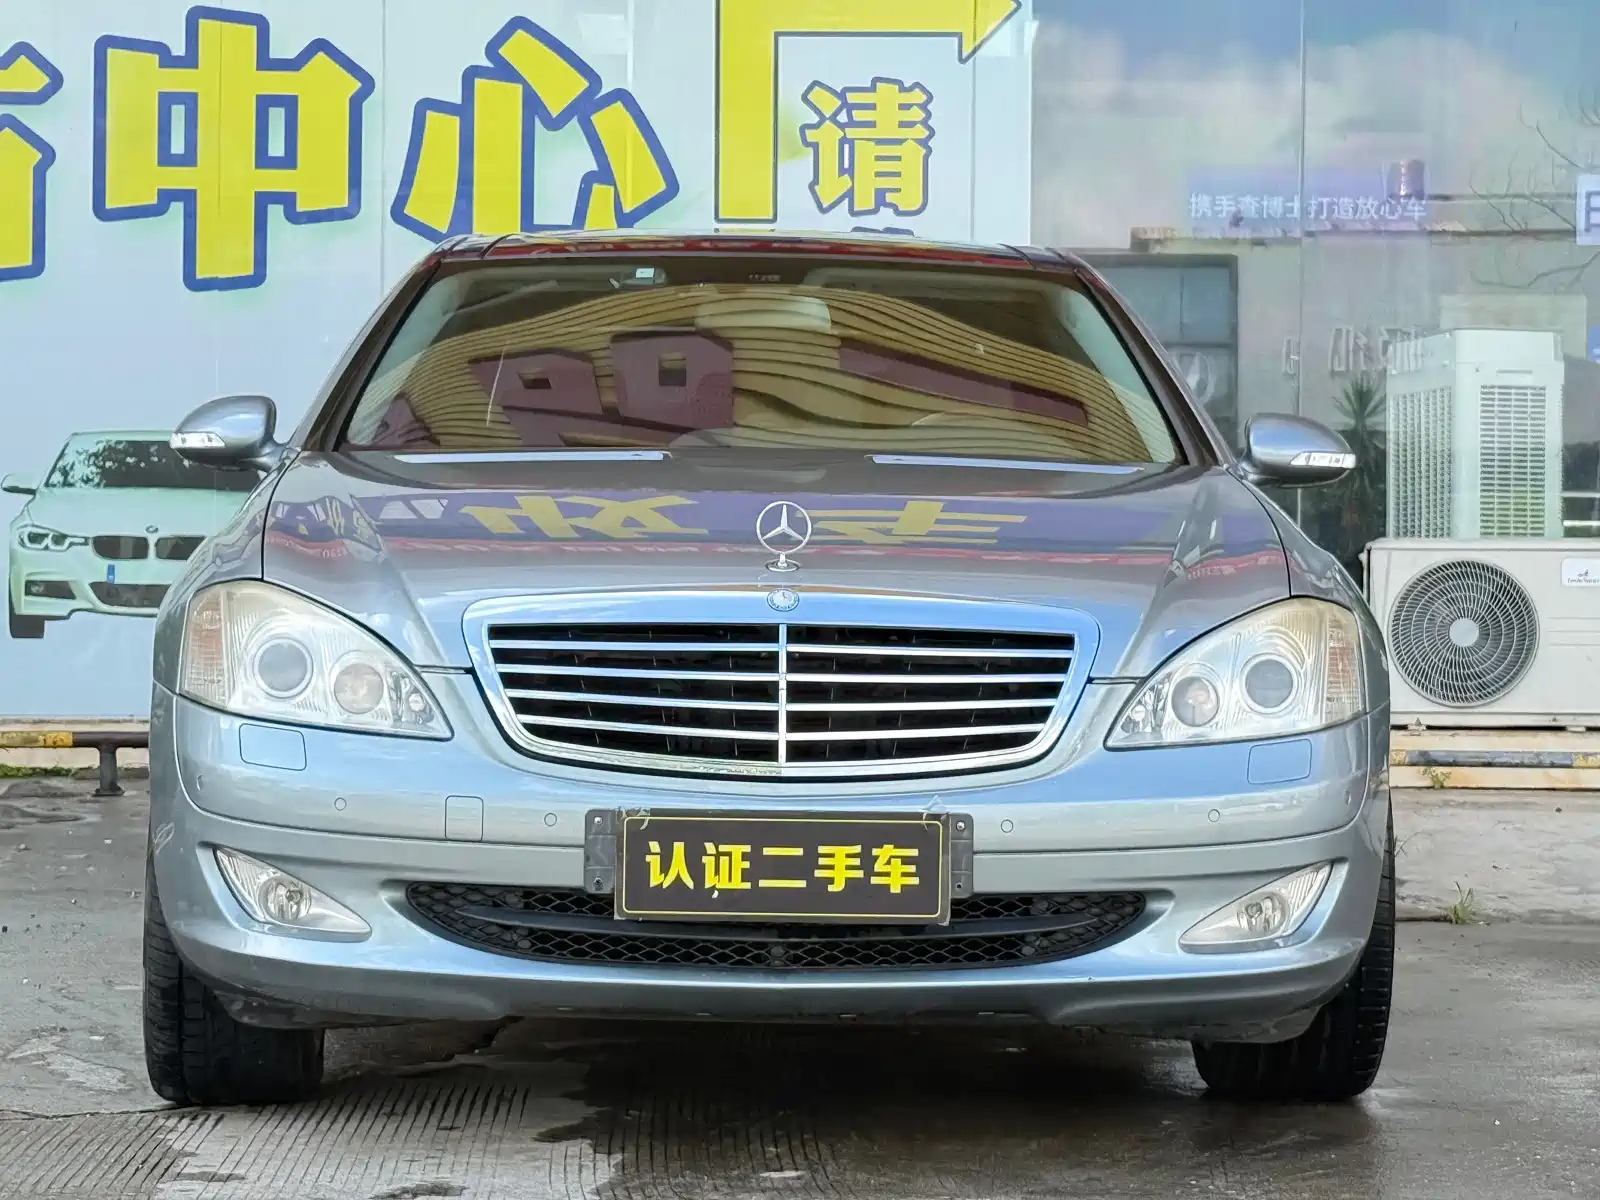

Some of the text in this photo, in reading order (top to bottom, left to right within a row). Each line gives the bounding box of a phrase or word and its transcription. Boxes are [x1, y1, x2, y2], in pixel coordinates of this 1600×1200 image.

[0, 5, 679, 291] 中心
[799, 77, 935, 217] 请
[645, 840, 920, 894] 认证二手车
